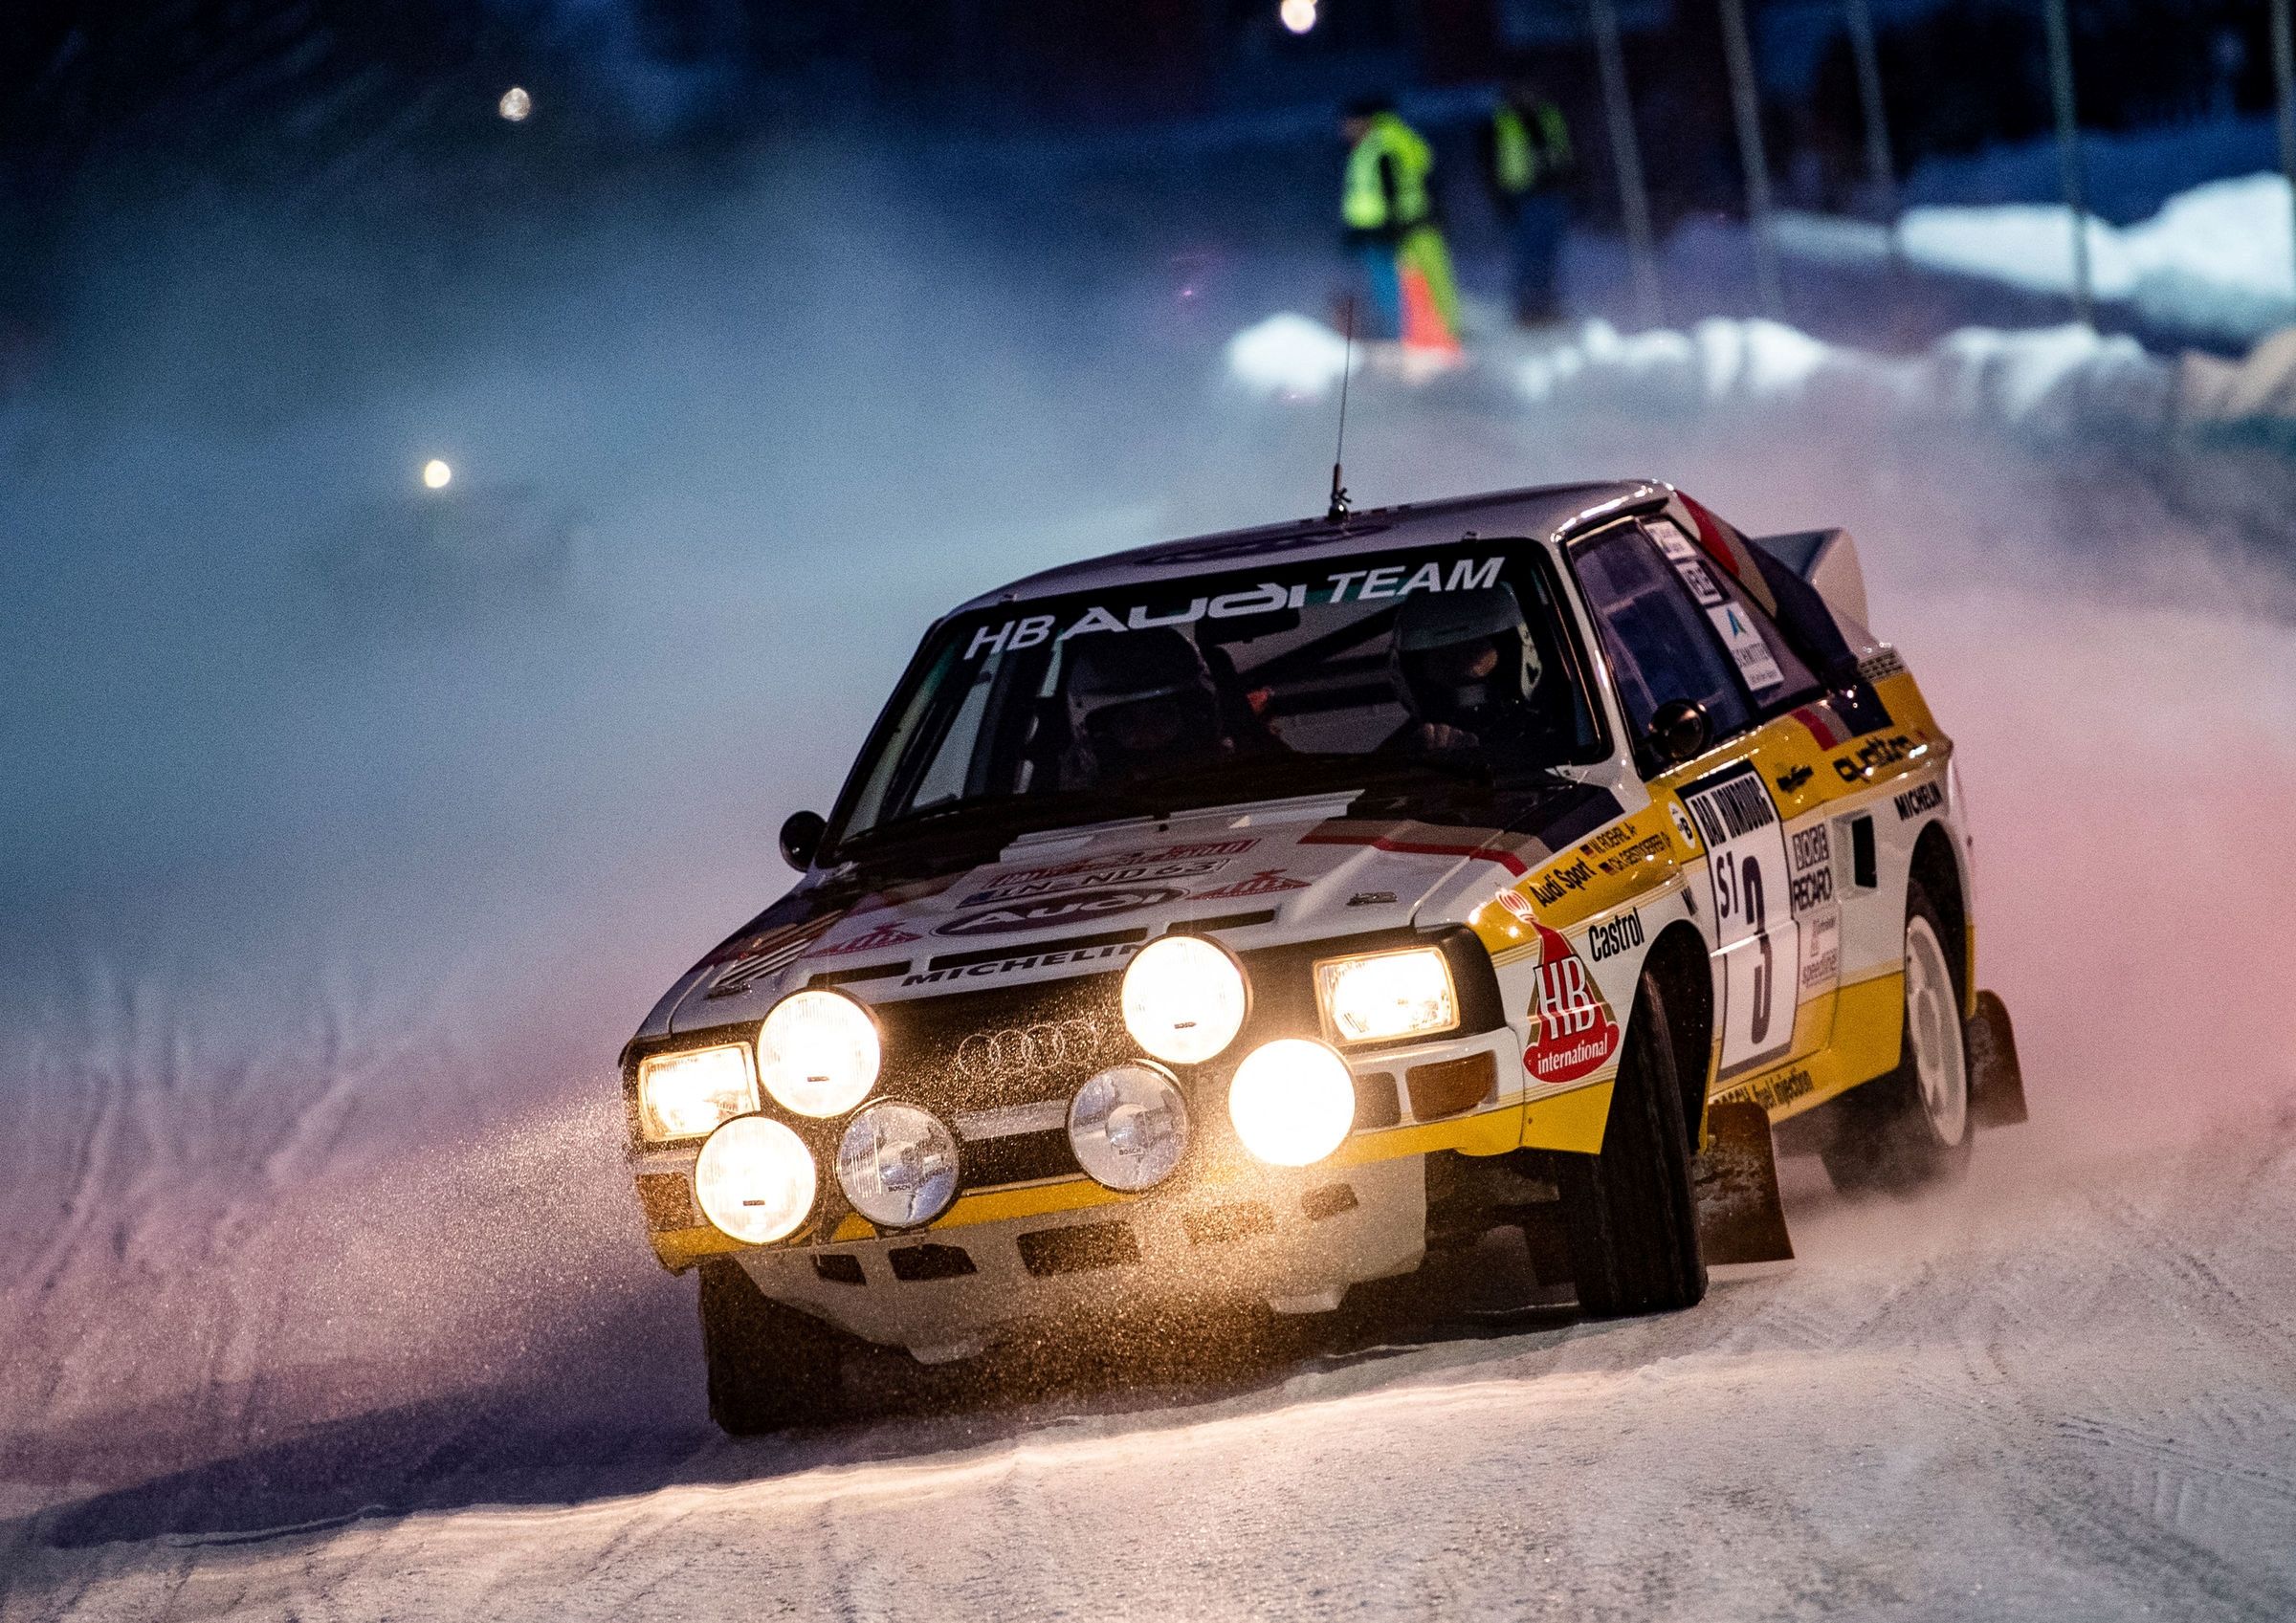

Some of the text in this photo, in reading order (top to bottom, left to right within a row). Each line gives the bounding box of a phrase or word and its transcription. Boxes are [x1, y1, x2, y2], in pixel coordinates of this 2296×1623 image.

[963, 615, 1055, 660] HB
[1325, 557, 1505, 603] TEAM
[1893, 780, 1943, 822] MICHELIN
[1530, 857, 1597, 908] Audi Sport
[1792, 866, 1832, 910] RECARO
[1588, 907, 1645, 962] Castrol
[1742, 855, 1772, 1045] 3
[1533, 954, 1595, 1040] HB
[1537, 1033, 1608, 1074] international
